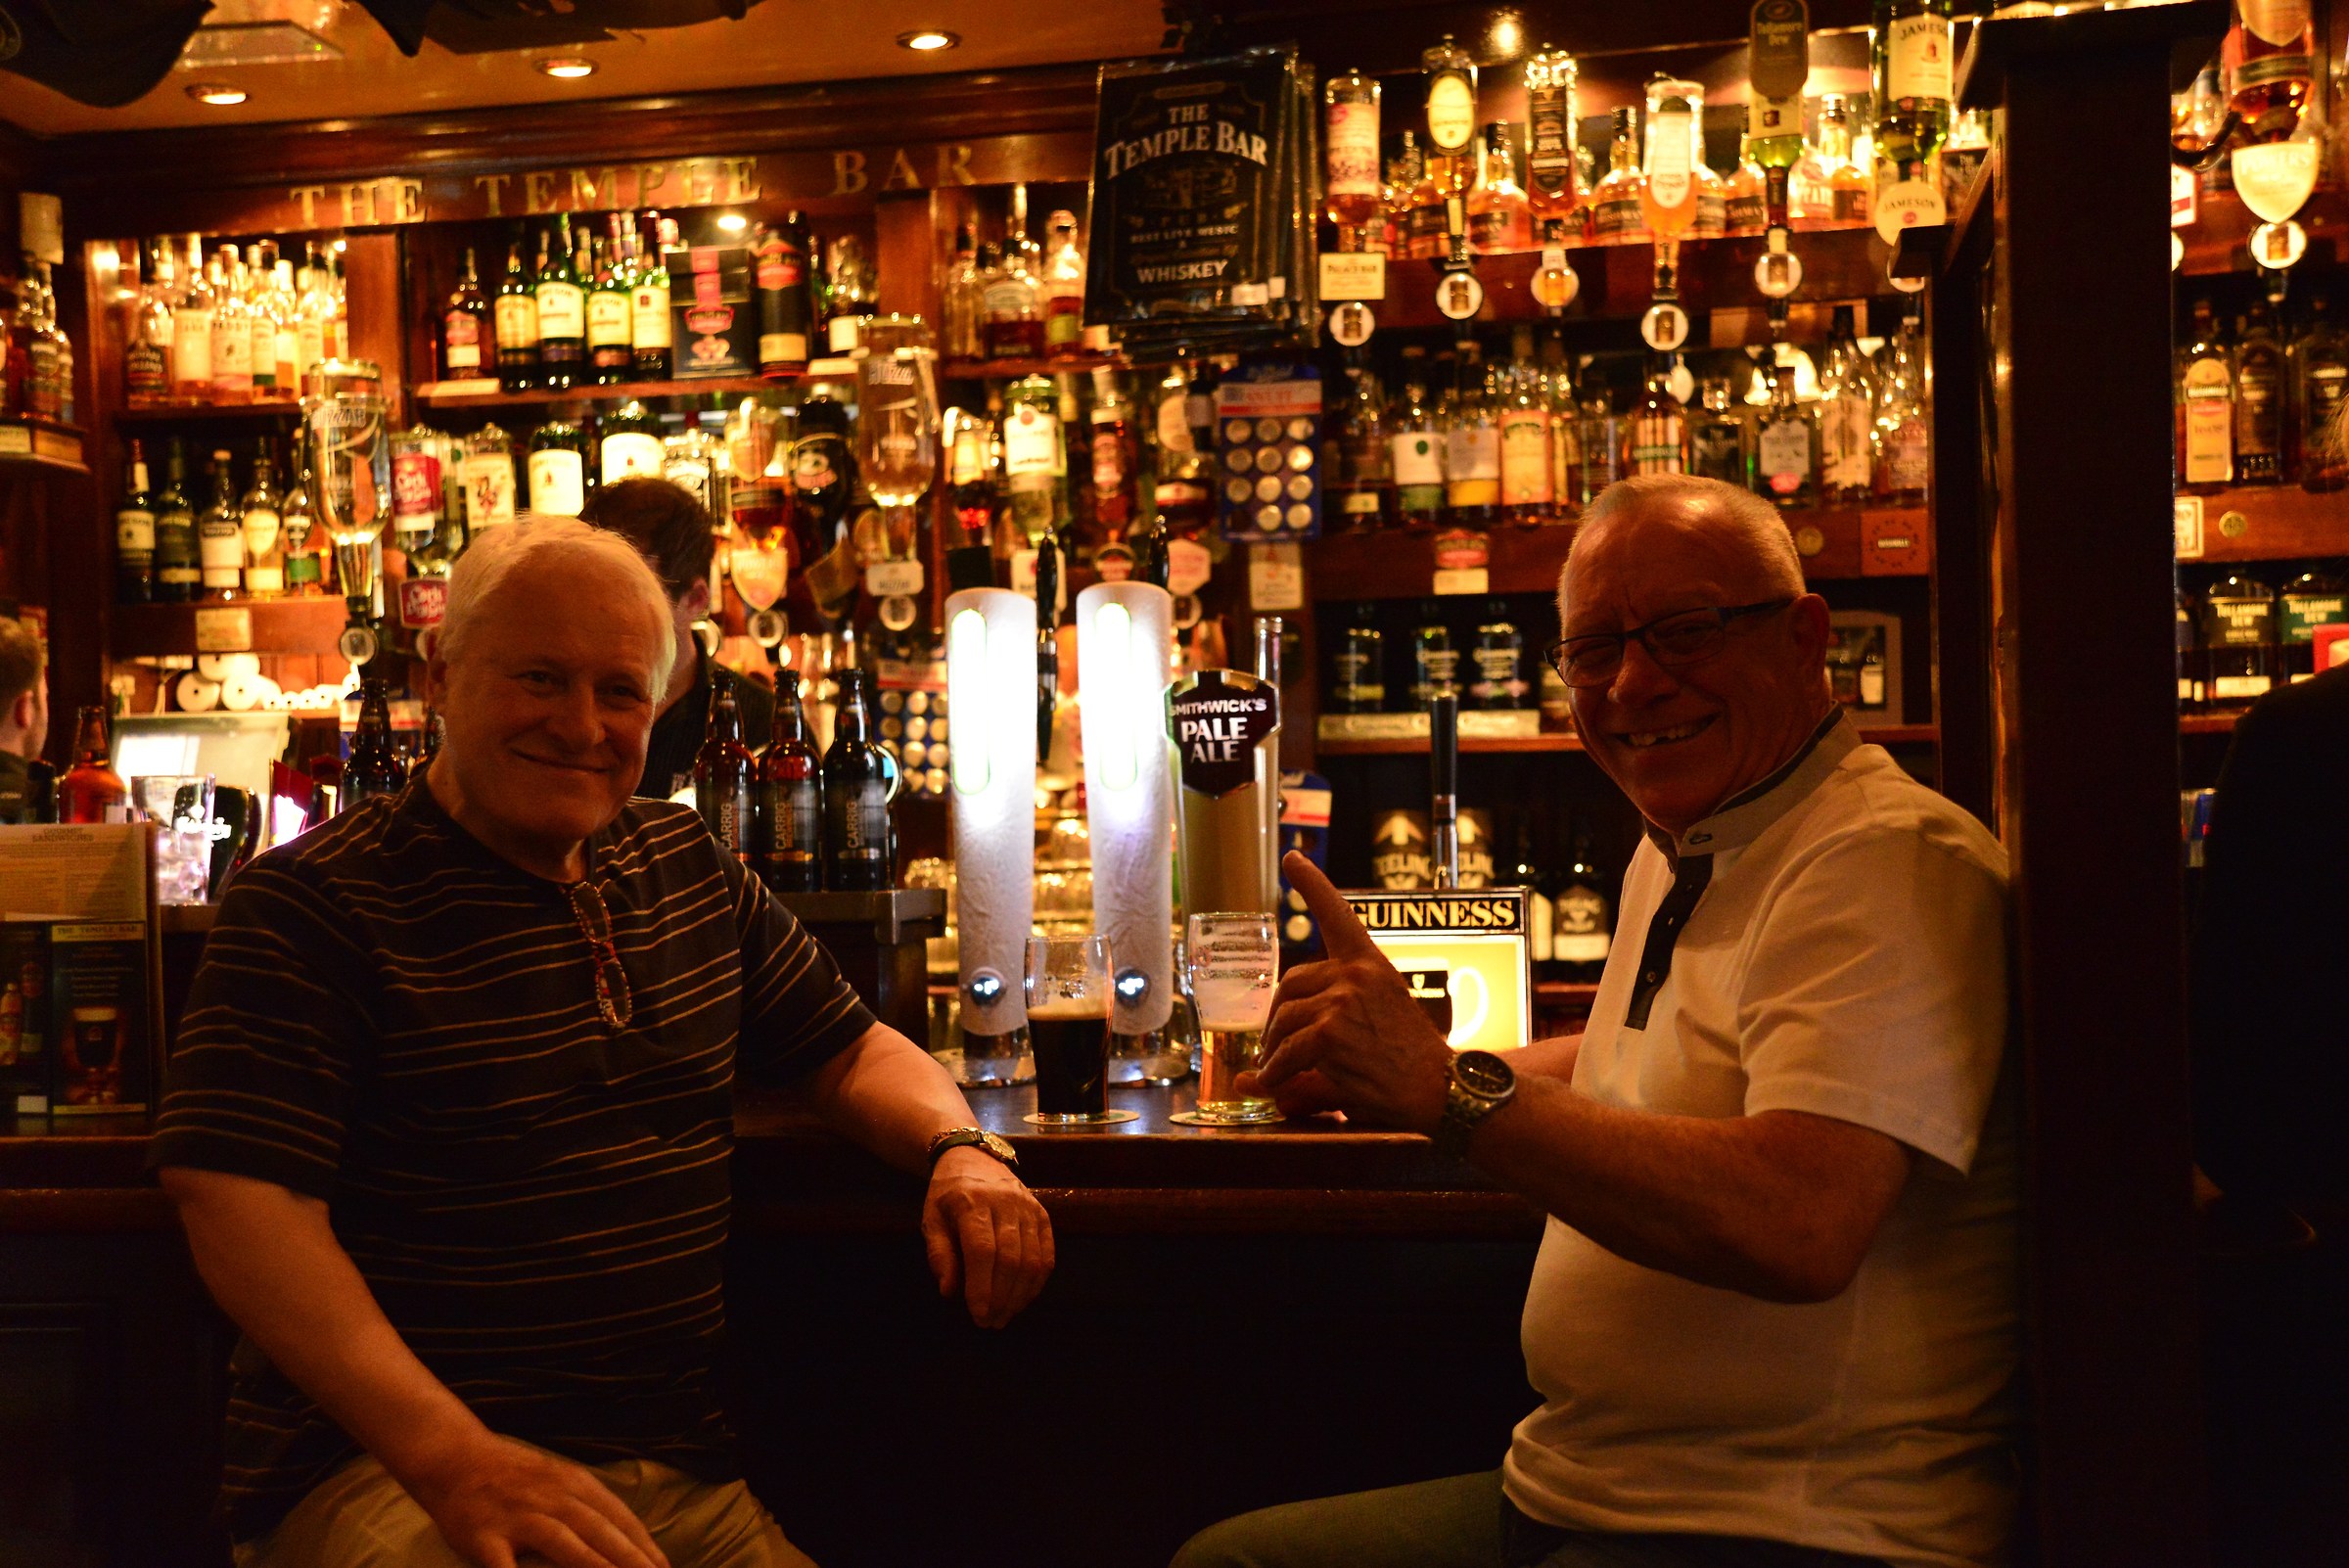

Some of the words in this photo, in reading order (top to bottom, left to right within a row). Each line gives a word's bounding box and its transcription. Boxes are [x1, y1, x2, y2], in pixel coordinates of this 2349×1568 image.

[1168, 103, 1209, 124] THE
[1103, 124, 1211, 180] TEMPLE
[1215, 119, 1268, 167] BAR
[292, 177, 429, 229] THE
[475, 156, 760, 217] TEMPLE
[832, 143, 977, 195] BAR
[1884, 198, 1936, 213] JAMESON
[1136, 259, 1228, 284] WHISKEY
[1170, 698, 1267, 716] SMITHWICK'S
[1180, 716, 1248, 742] PALE
[1191, 741, 1240, 763] ALE
[720, 803, 732, 850] CARRIG
[775, 802, 786, 850] CARRIG
[846, 801, 858, 849] CARRIG
[1350, 899, 1516, 929] GUINNESS
